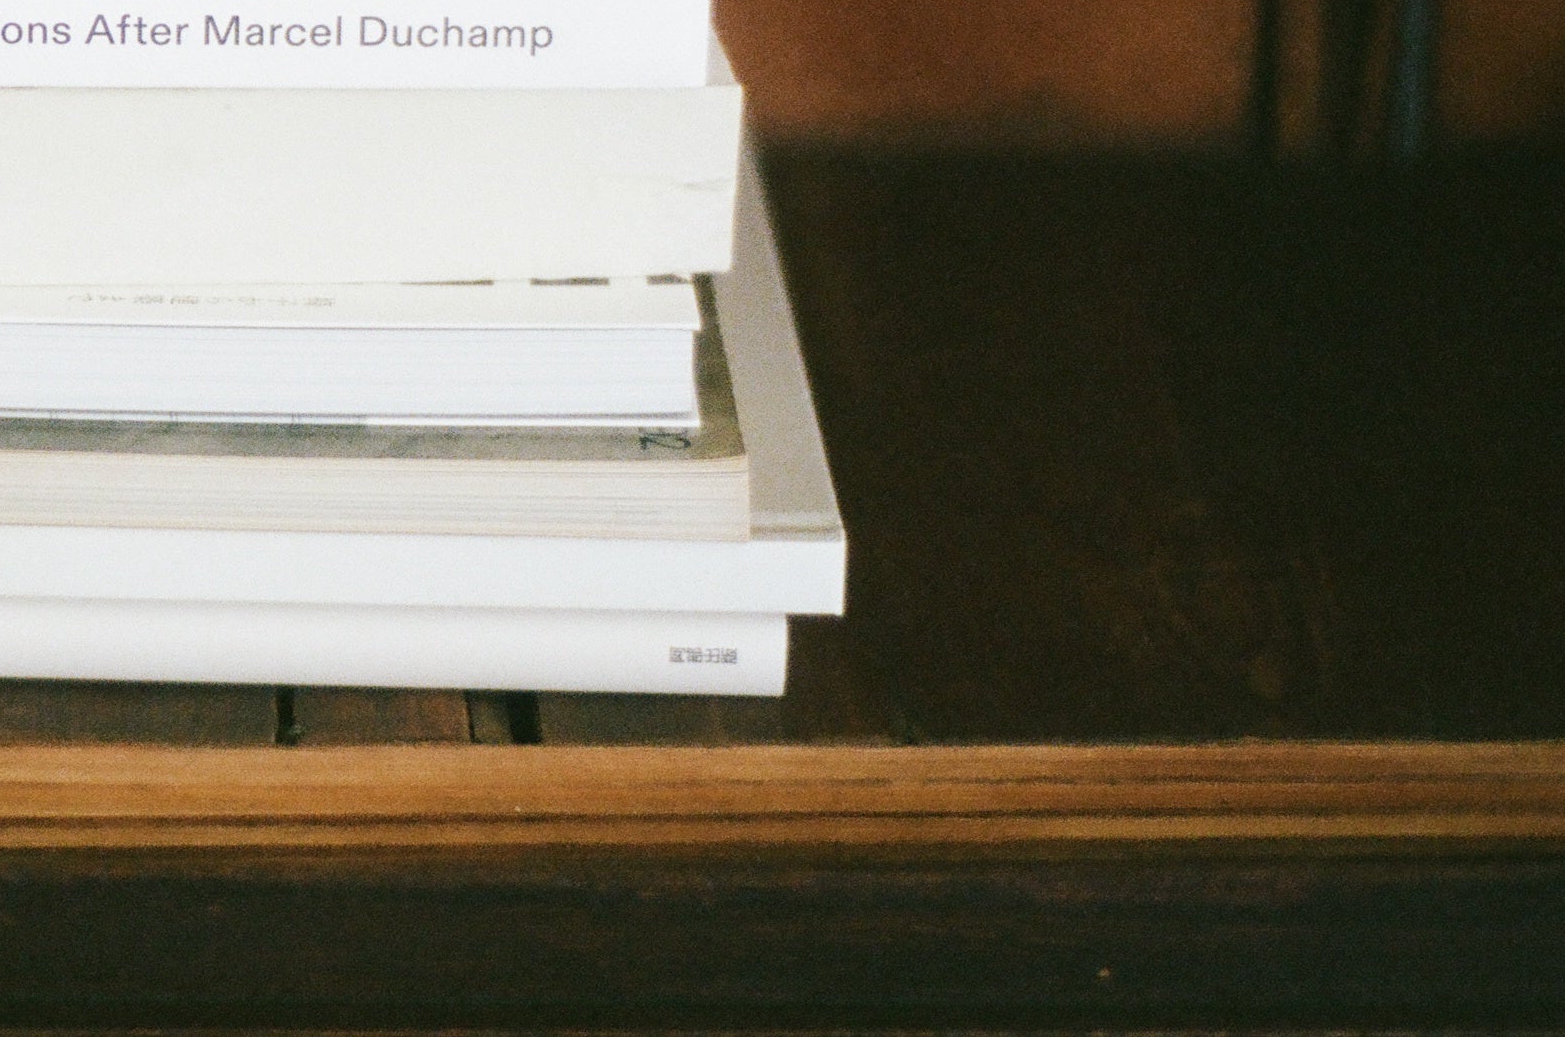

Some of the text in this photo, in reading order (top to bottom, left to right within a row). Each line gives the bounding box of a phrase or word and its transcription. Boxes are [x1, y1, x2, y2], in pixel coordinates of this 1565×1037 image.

[85, 13, 189, 46] After
[204, 14, 342, 47] Marcel
[359, 15, 554, 57] Duchamp
